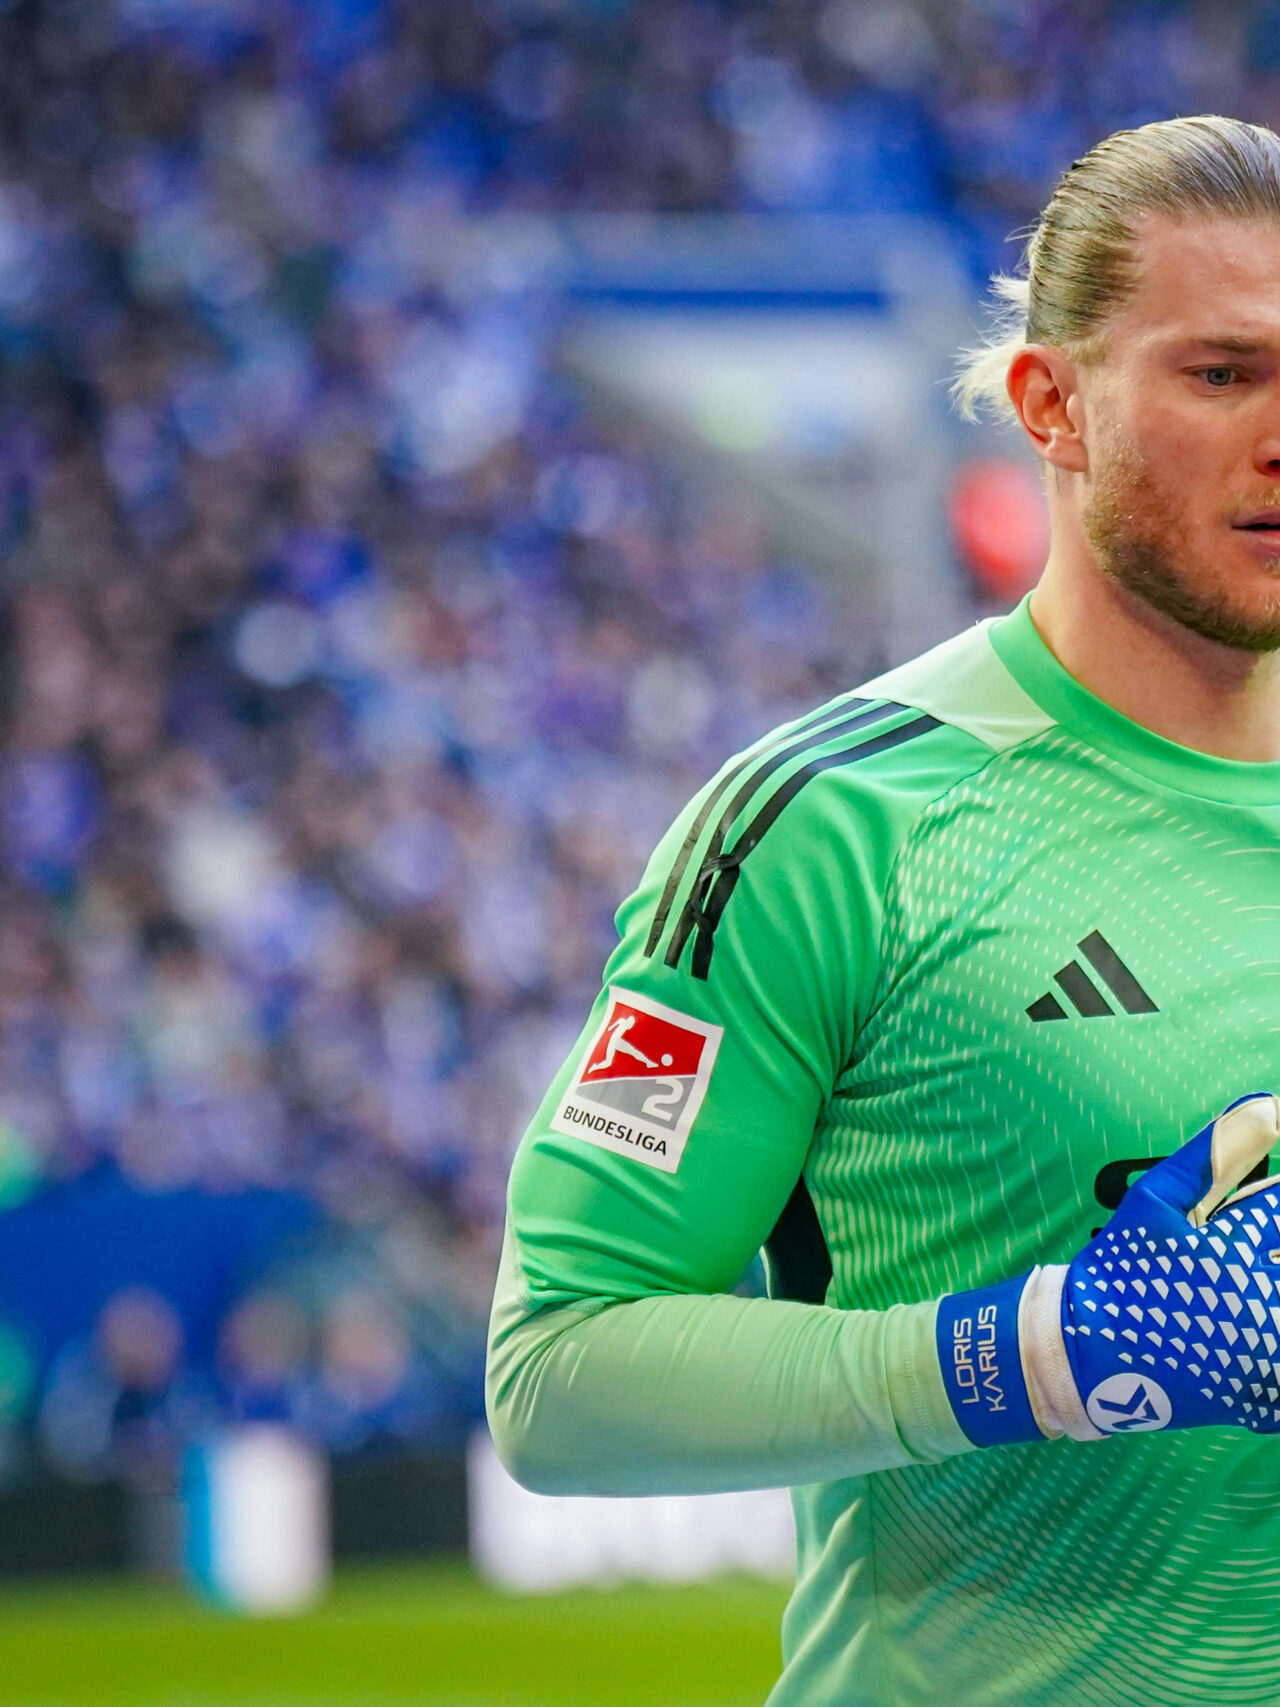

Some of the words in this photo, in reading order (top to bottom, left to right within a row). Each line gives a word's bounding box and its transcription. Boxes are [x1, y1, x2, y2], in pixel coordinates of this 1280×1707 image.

[563, 1105, 667, 1156] BUNDESLIGA
[642, 1078, 684, 1120] 2
[953, 1319, 980, 1405] LORIS
[977, 1305, 1007, 1412] KARIUS
